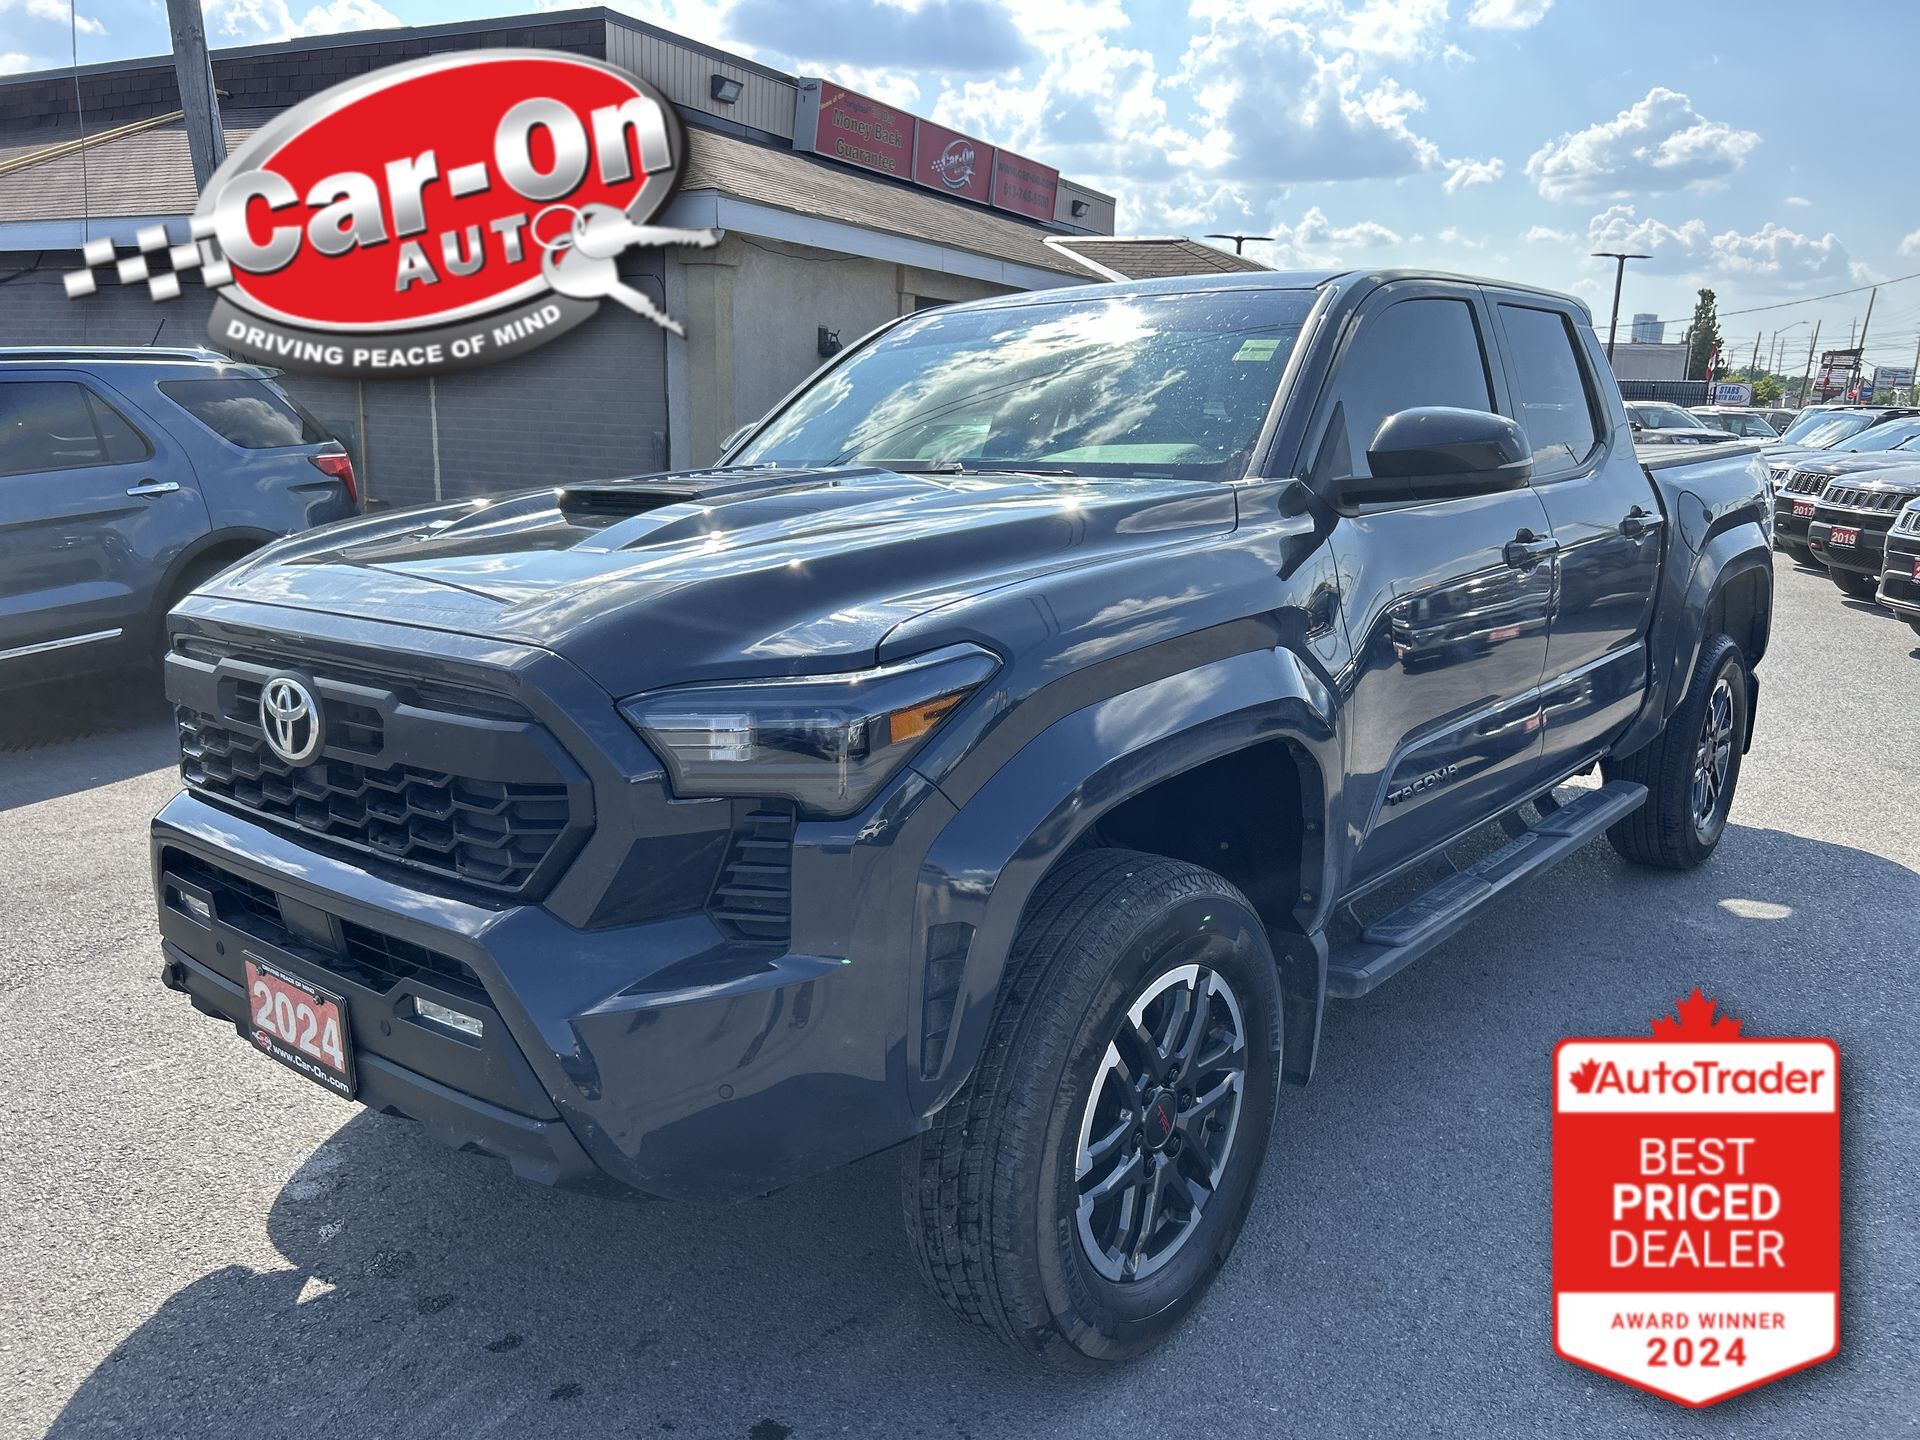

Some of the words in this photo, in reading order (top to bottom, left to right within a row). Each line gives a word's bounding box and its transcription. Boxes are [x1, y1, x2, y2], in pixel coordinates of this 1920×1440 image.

[832, 108, 872, 141] Money
[875, 123, 902, 148] Back
[835, 137, 896, 171] Guarantee
[941, 148, 975, 167] Car-On
[1793, 505, 1814, 517] 2017
[1831, 531, 1856, 545] 2019
[1387, 763, 1458, 805] TACOMA
[254, 980, 344, 1070] 2024
[273, 1044, 349, 1093] www.Car-On.com
